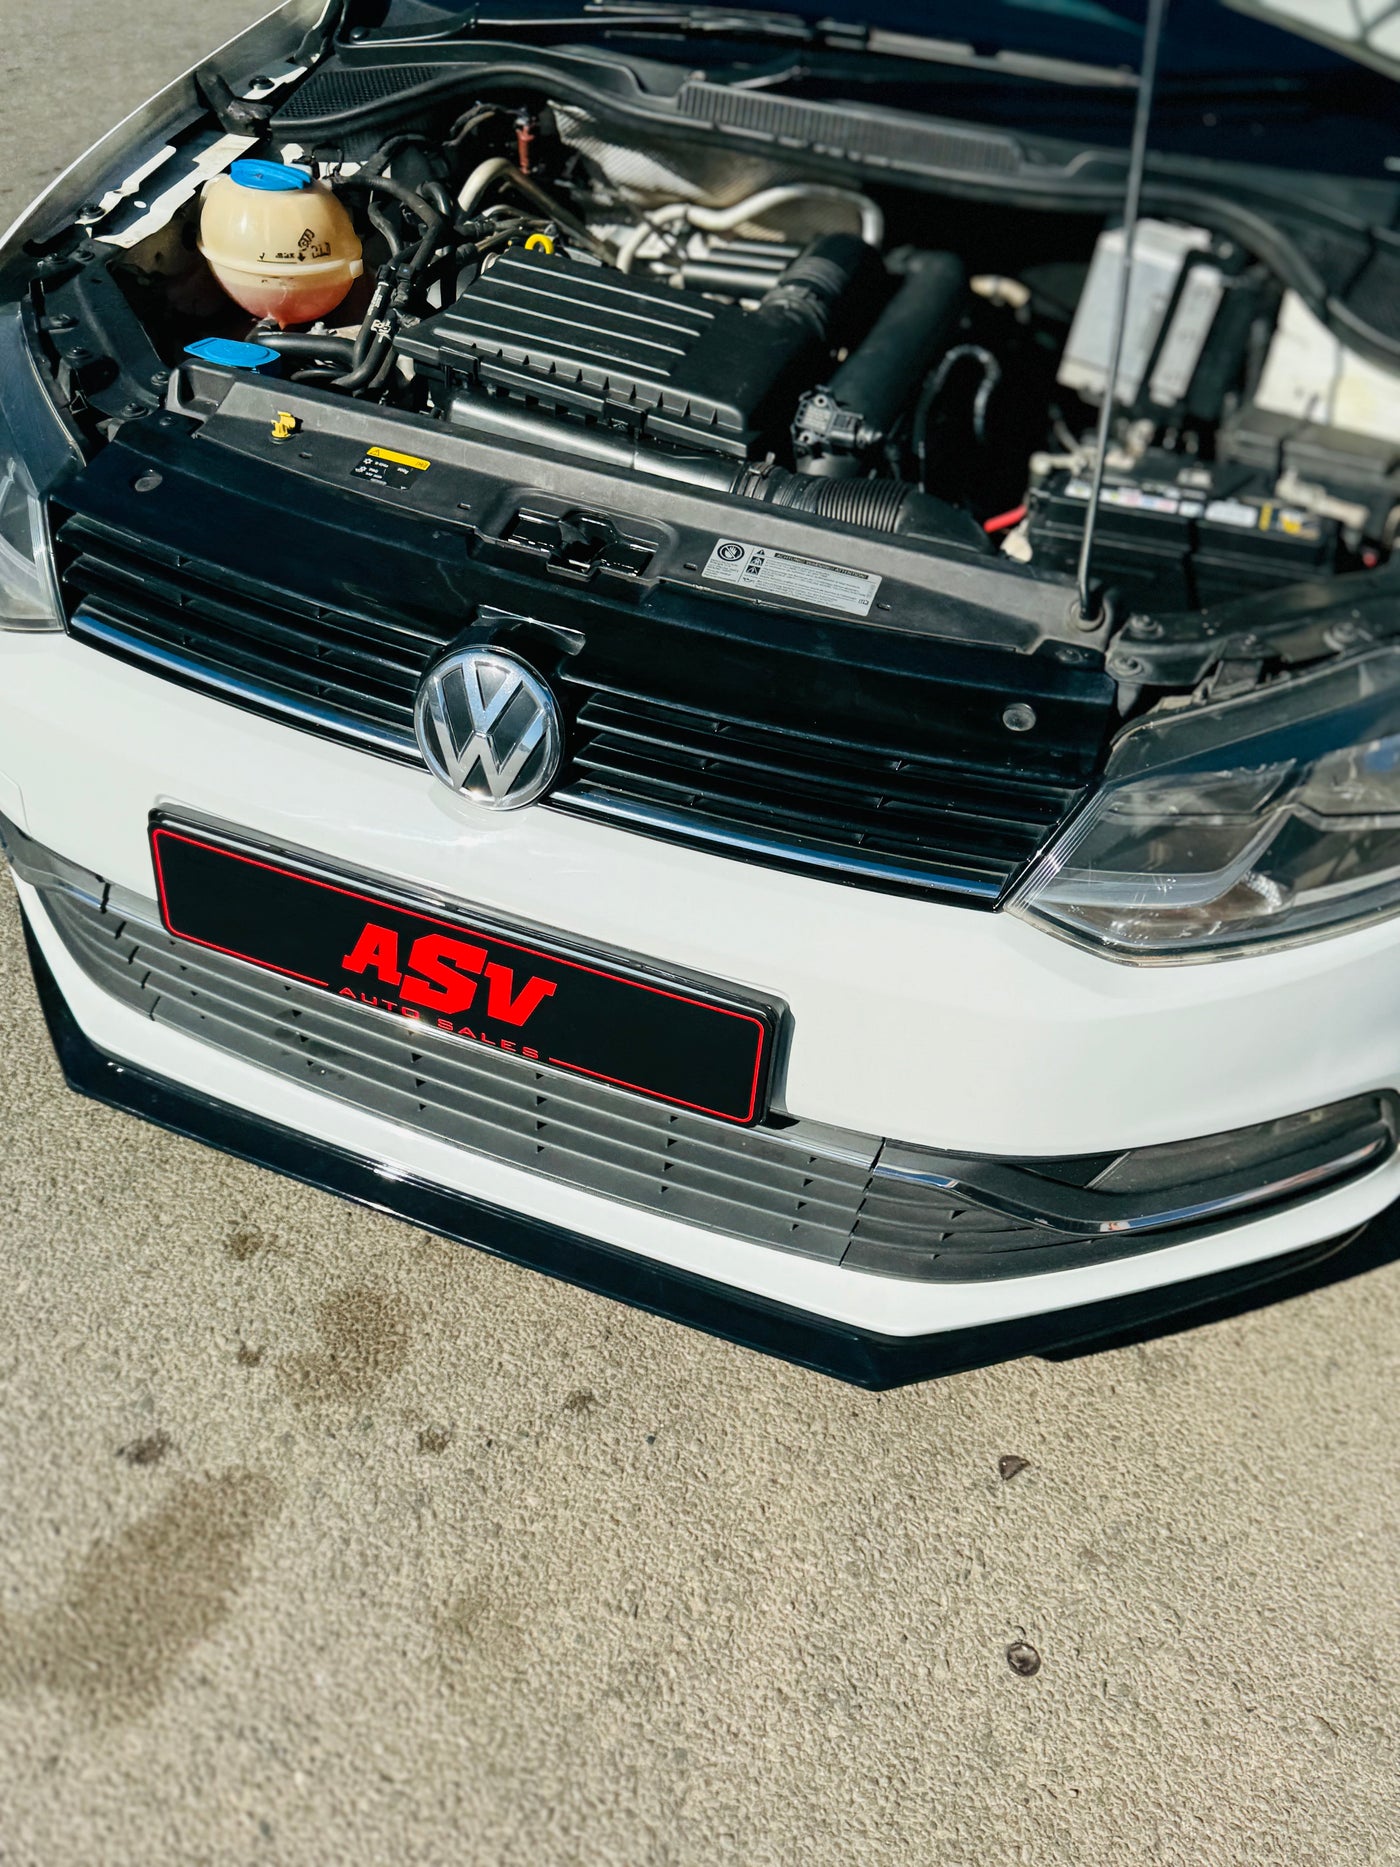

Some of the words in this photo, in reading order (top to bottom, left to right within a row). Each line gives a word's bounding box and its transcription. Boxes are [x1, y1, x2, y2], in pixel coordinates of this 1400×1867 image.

[341, 922, 558, 1027] ASV
[338, 986, 420, 1020] AUTO
[437, 1018, 539, 1060] SALES
